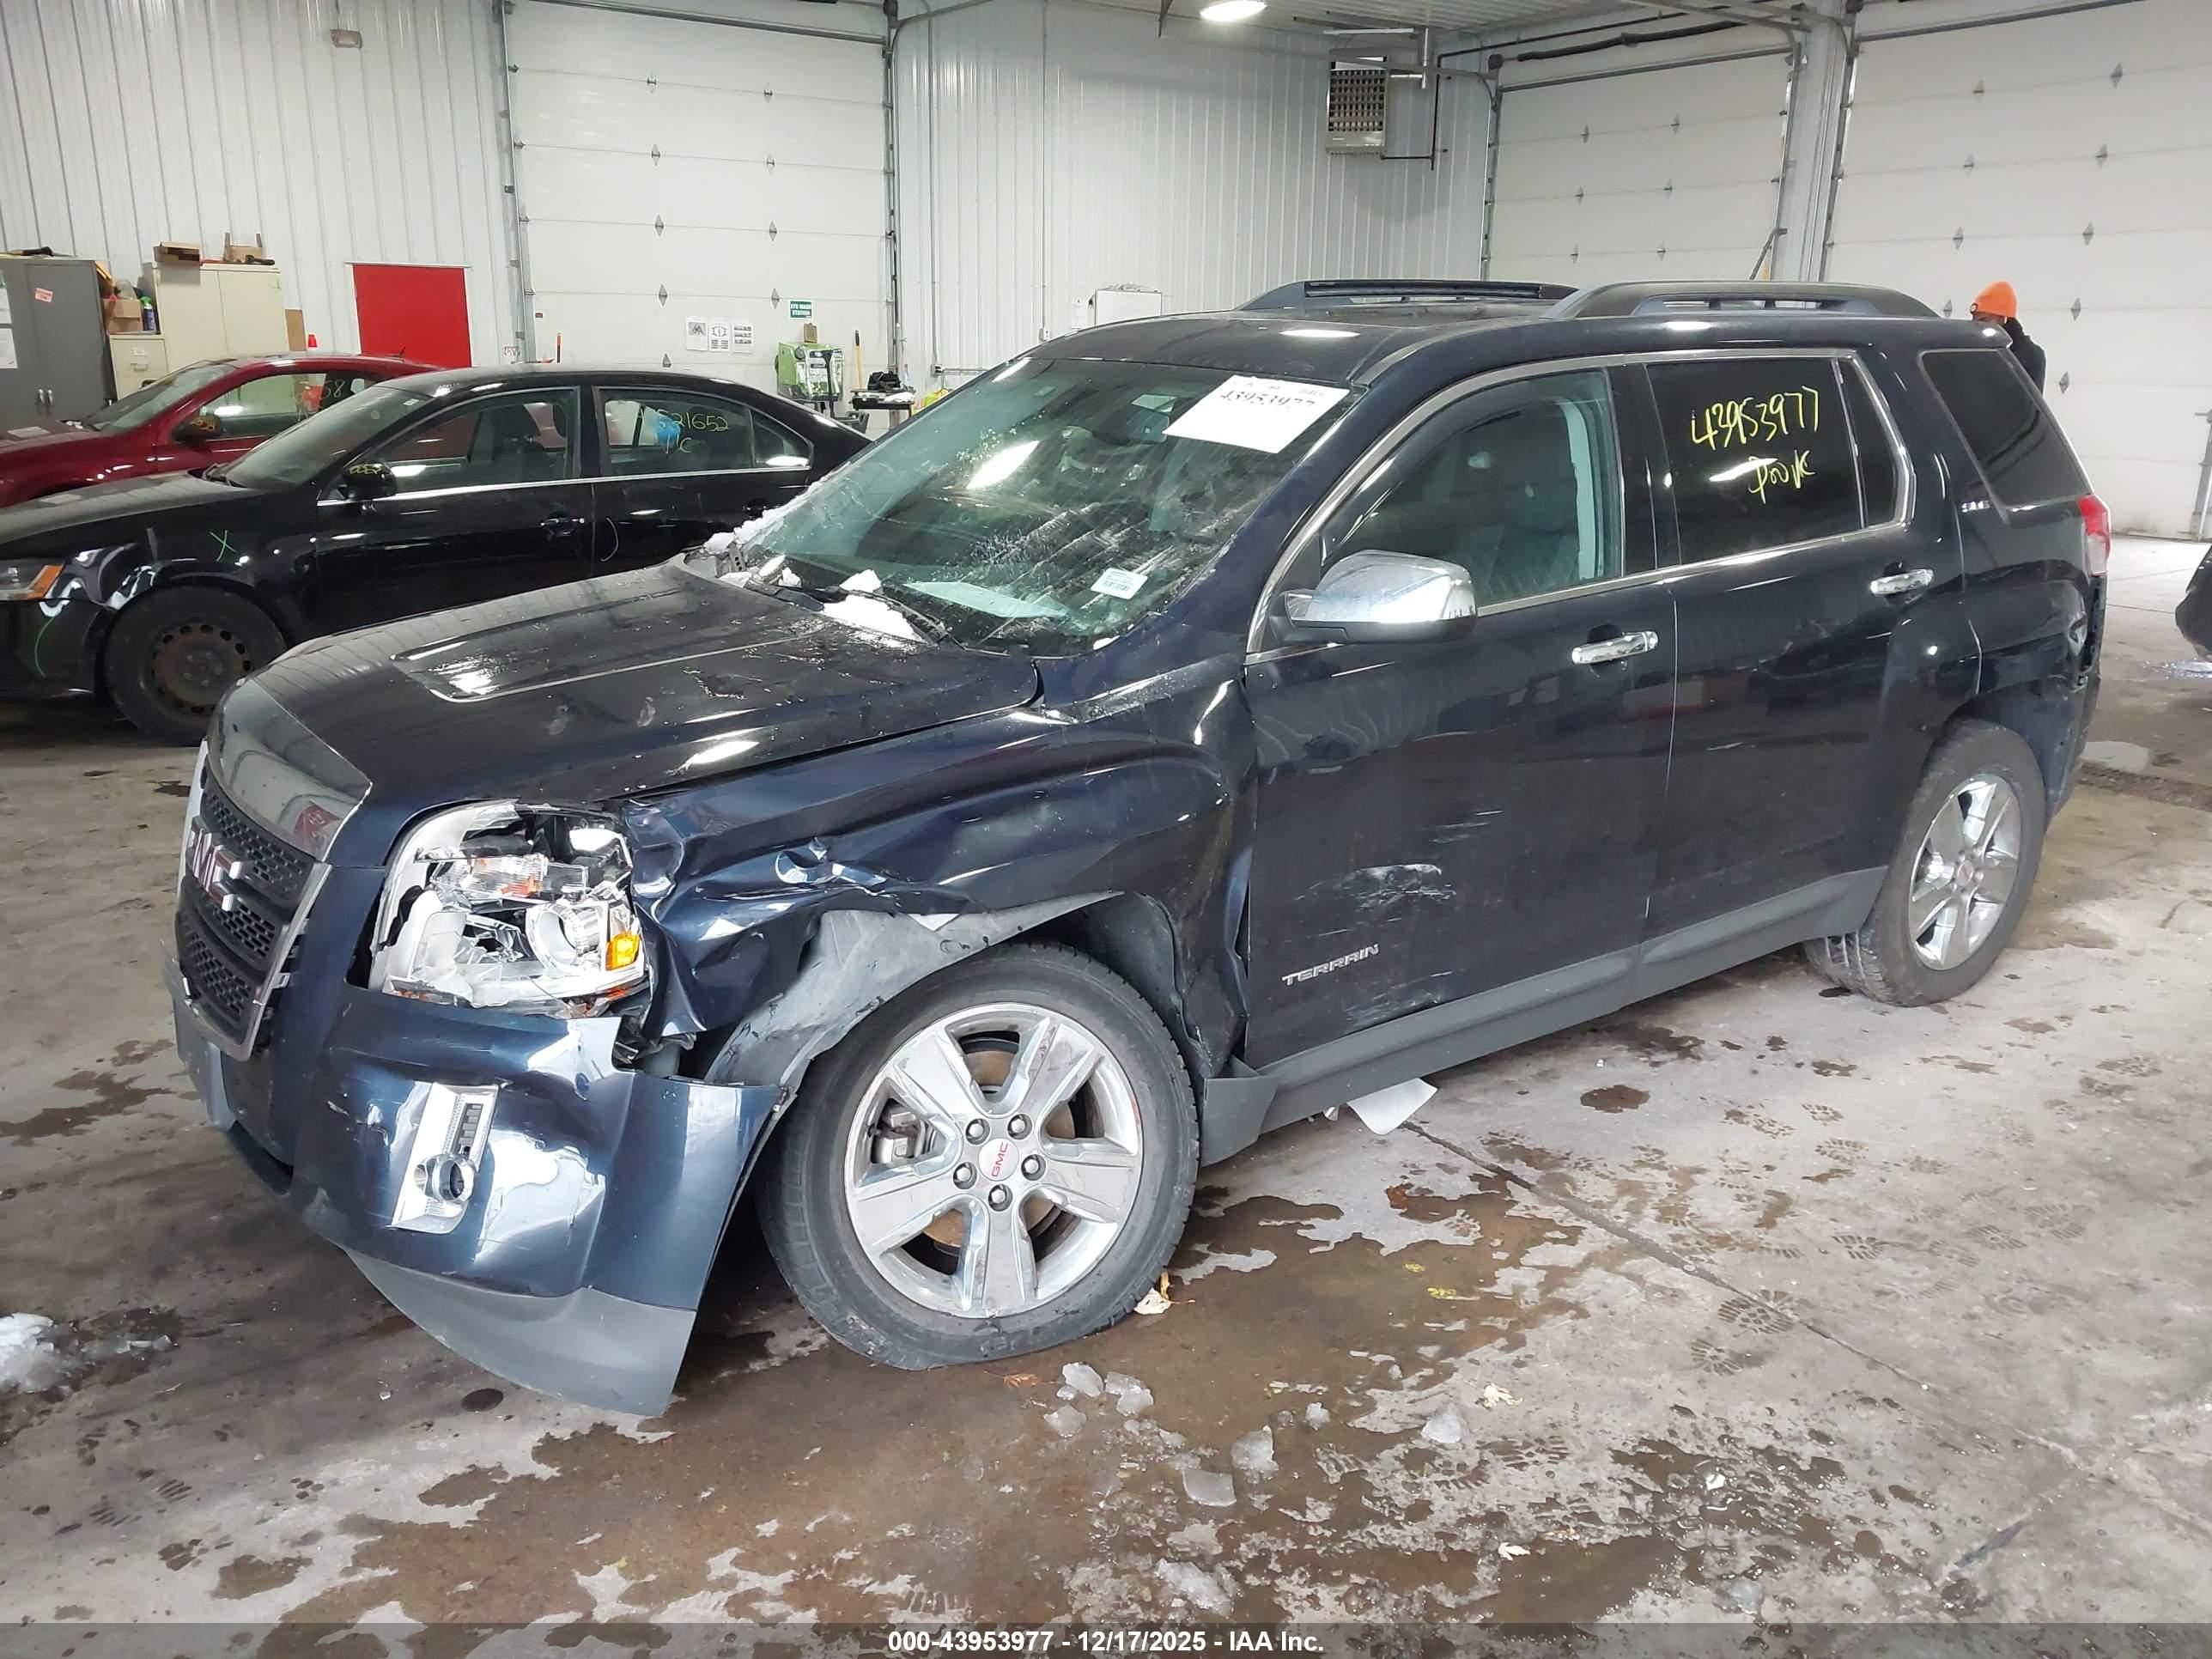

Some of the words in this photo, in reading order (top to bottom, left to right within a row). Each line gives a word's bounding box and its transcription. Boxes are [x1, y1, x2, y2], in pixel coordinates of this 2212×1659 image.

[1691, 386, 1819, 451] 43953977
[1281, 943, 1379, 986] TERRAIN
[992, 1141, 1009, 1177] GMC
